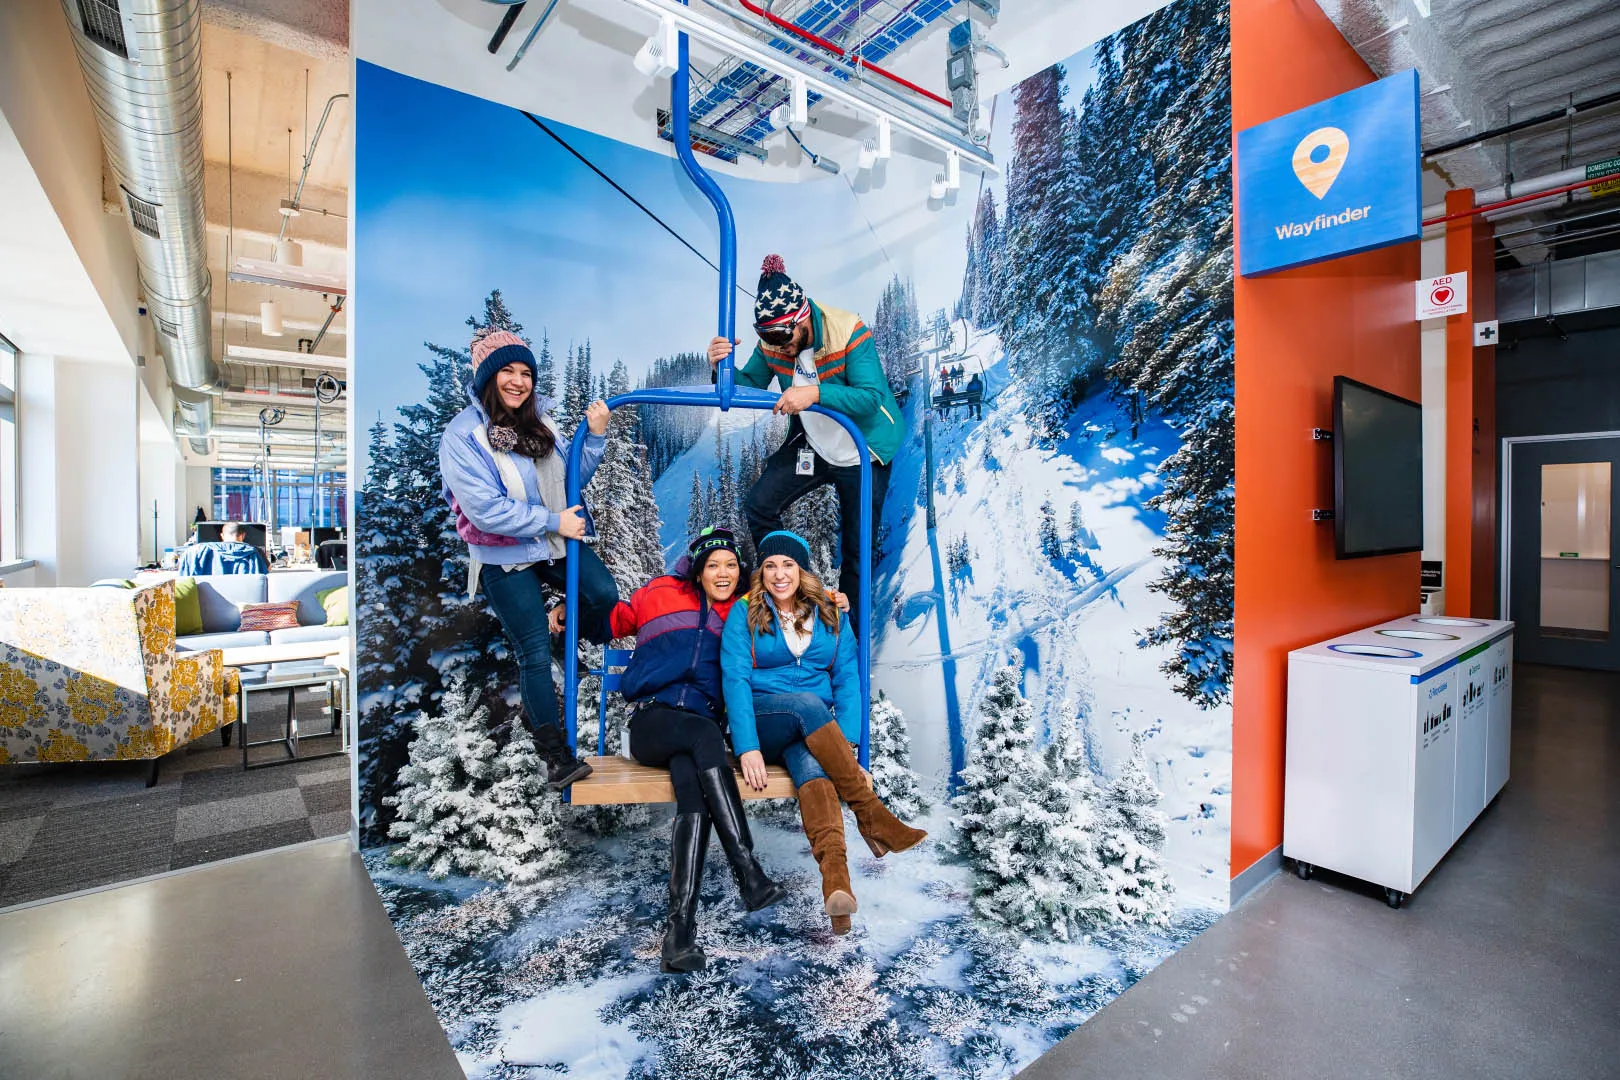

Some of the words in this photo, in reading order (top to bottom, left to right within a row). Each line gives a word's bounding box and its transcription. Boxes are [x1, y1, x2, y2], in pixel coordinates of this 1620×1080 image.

[1587, 161, 1613, 173] DOMESTIC
[1274, 205, 1372, 241] Wayfinder
[1432, 276, 1453, 287] AED
[705, 539, 729, 548] CAT
